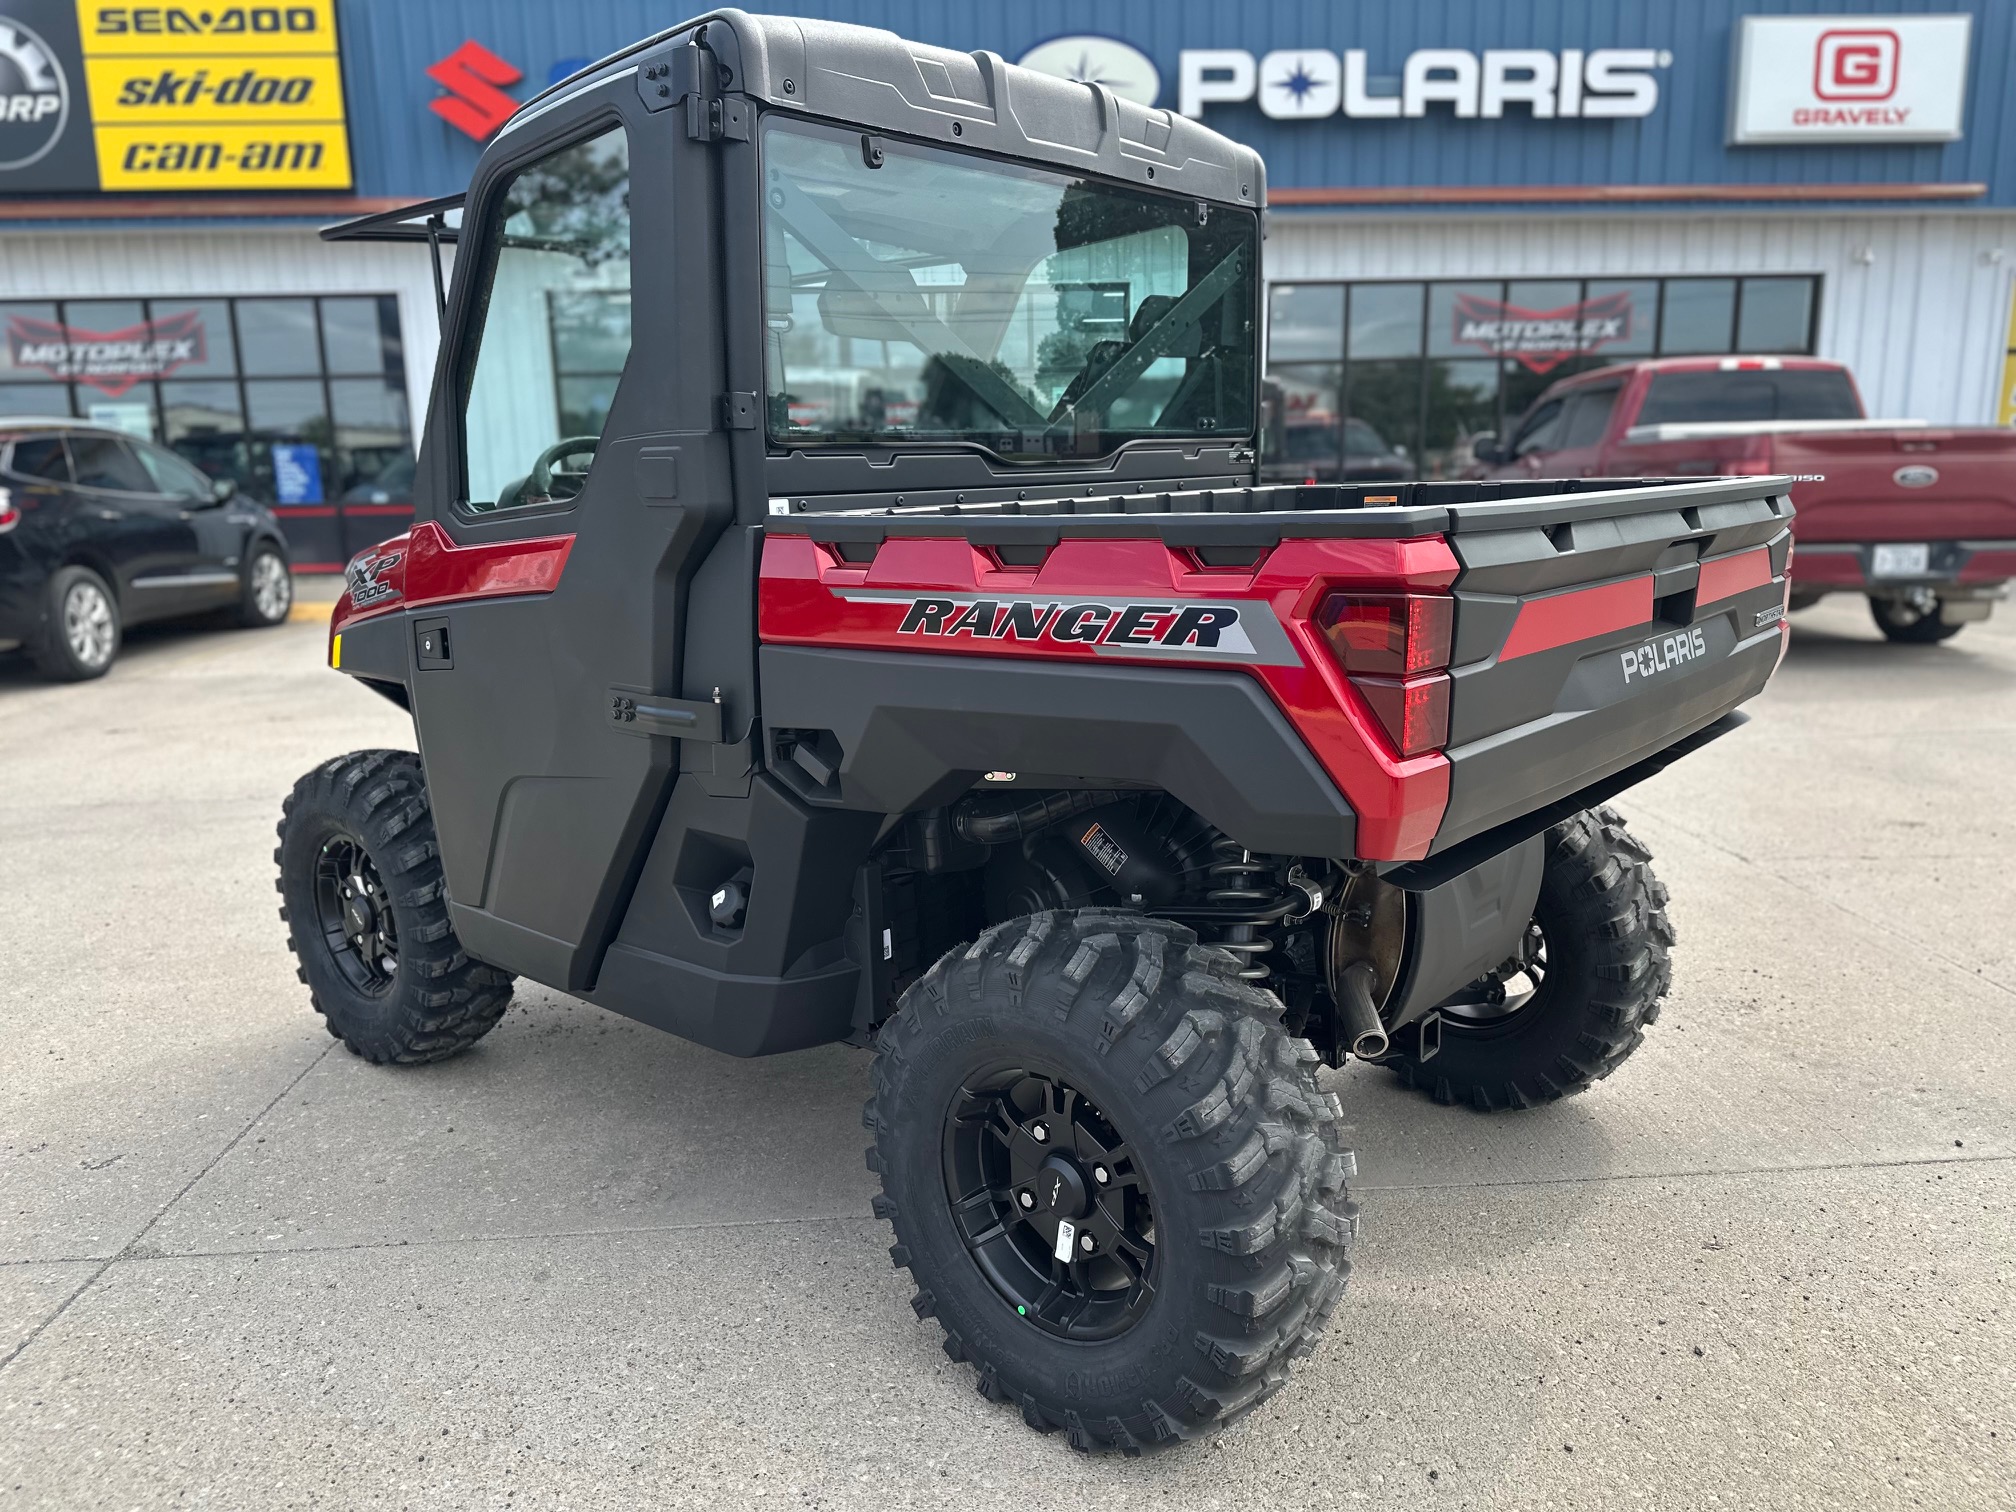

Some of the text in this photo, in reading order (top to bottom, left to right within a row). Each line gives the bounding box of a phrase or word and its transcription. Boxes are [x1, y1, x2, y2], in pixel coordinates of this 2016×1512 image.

[117, 69, 315, 106] ski-doo
[1179, 49, 1659, 119] POLARIS
[1793, 107, 1909, 126] GRAVELY
[122, 143, 325, 171] can-am
[1461, 317, 1622, 340] MOTOPLEX
[19, 339, 195, 363] MOTOPLEX
[350, 553, 402, 589] XP
[353, 580, 390, 604] 1000
[897, 597, 1240, 647] RANGER
[1620, 627, 1706, 684] POLARIS
